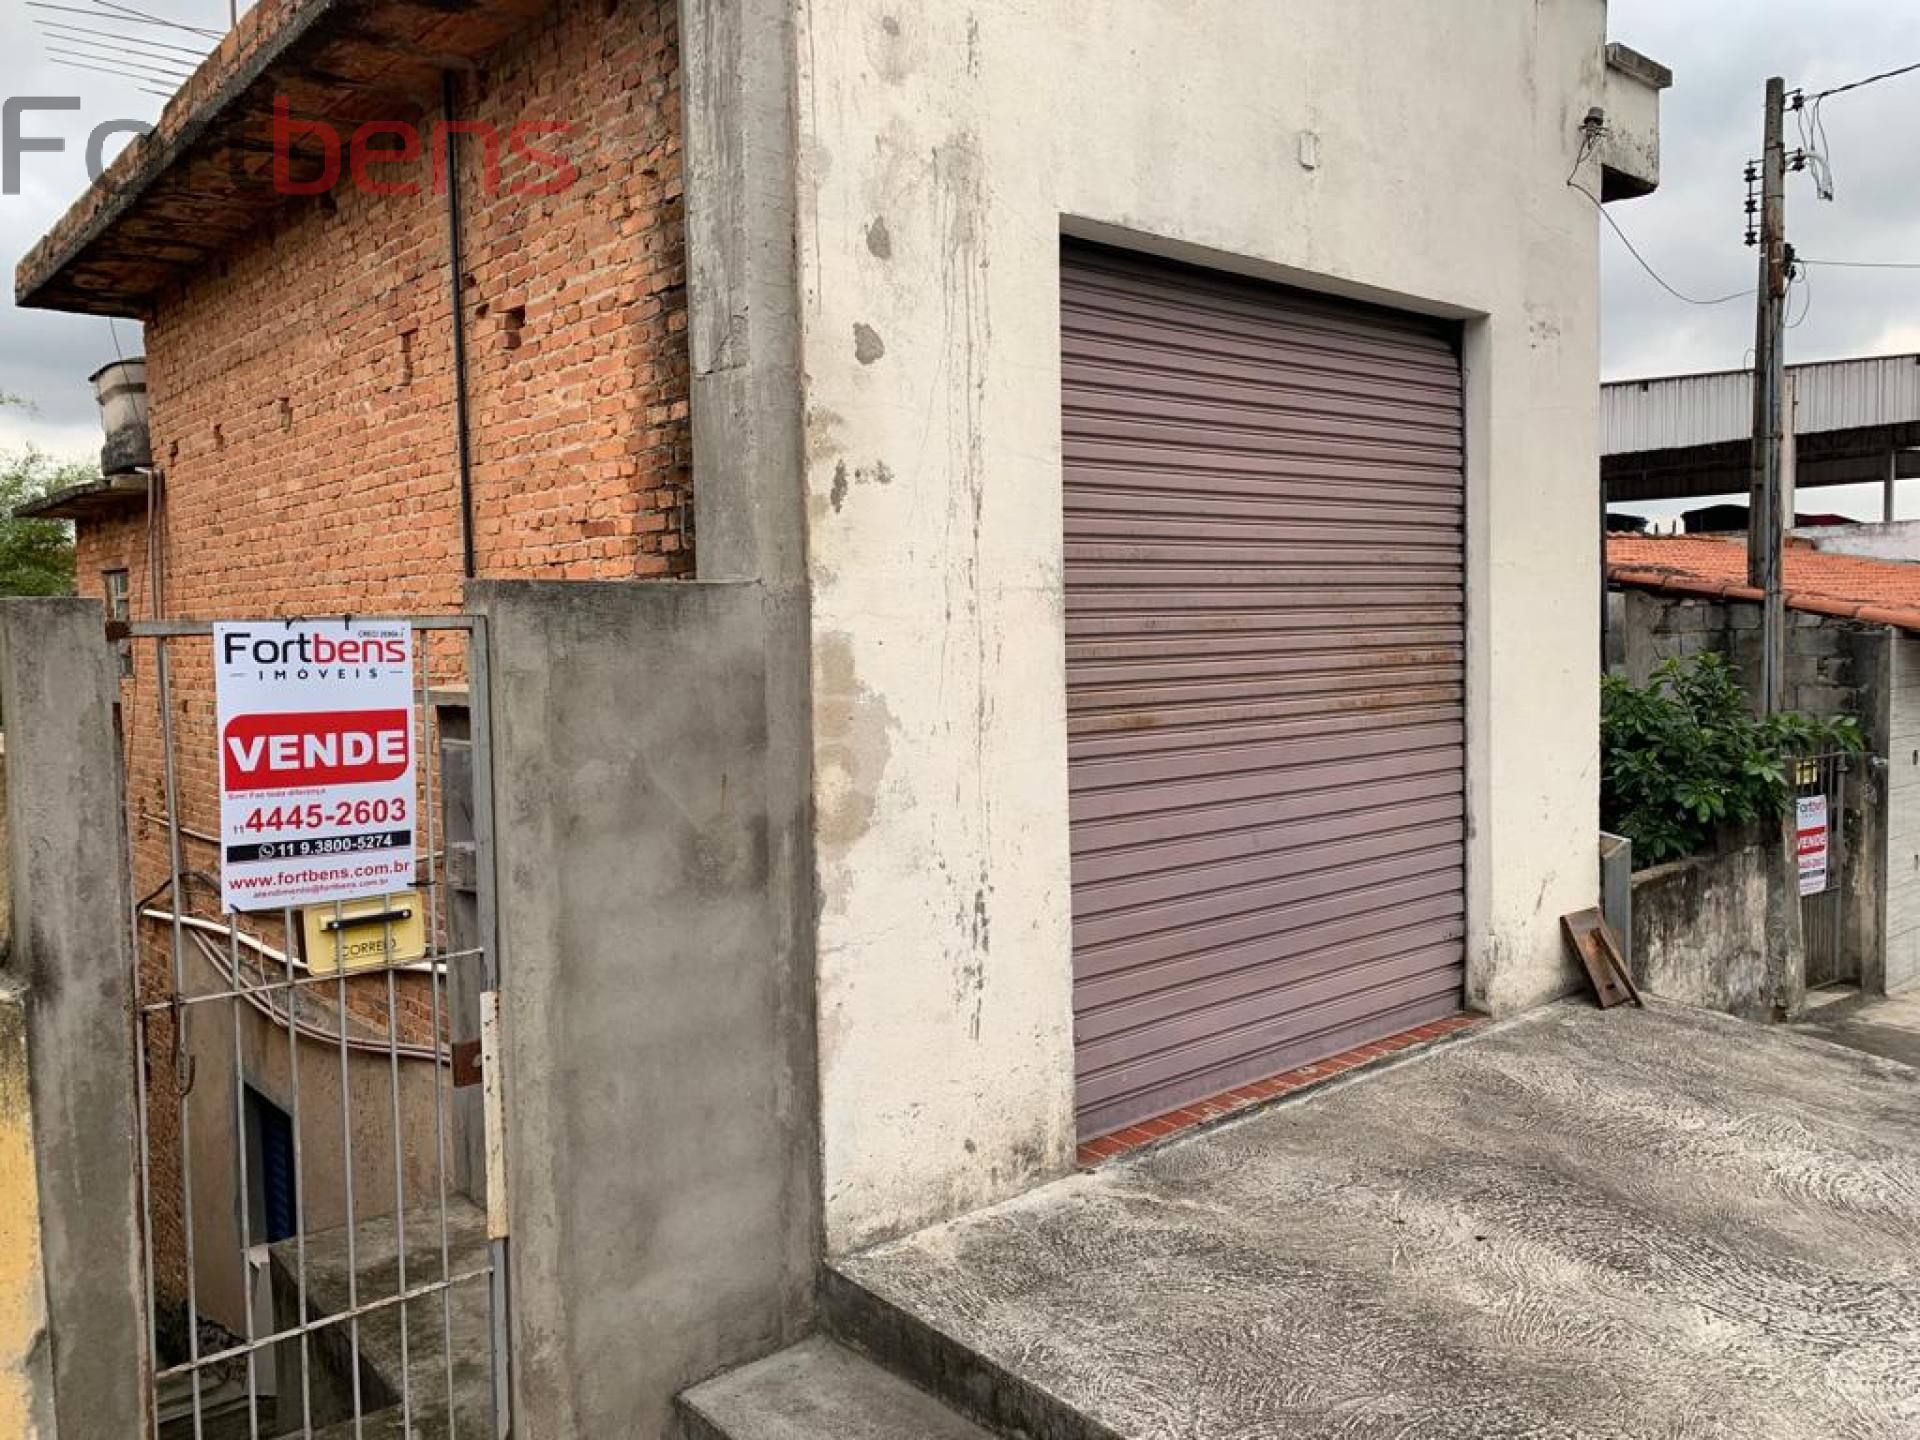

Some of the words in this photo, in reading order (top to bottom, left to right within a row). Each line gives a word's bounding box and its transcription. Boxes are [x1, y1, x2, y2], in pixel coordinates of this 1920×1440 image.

[224, 632, 406, 664] Fortbens
[258, 666, 378, 681] IMÓVEIS
[227, 730, 406, 772] VENDE
[245, 798, 406, 833] 4445-2603
[278, 843, 294, 856] 11
[299, 834, 393, 855] 9.3800-5274
[229, 860, 410, 890] www.fortbens.com.br
[342, 938, 397, 957] CORREO
